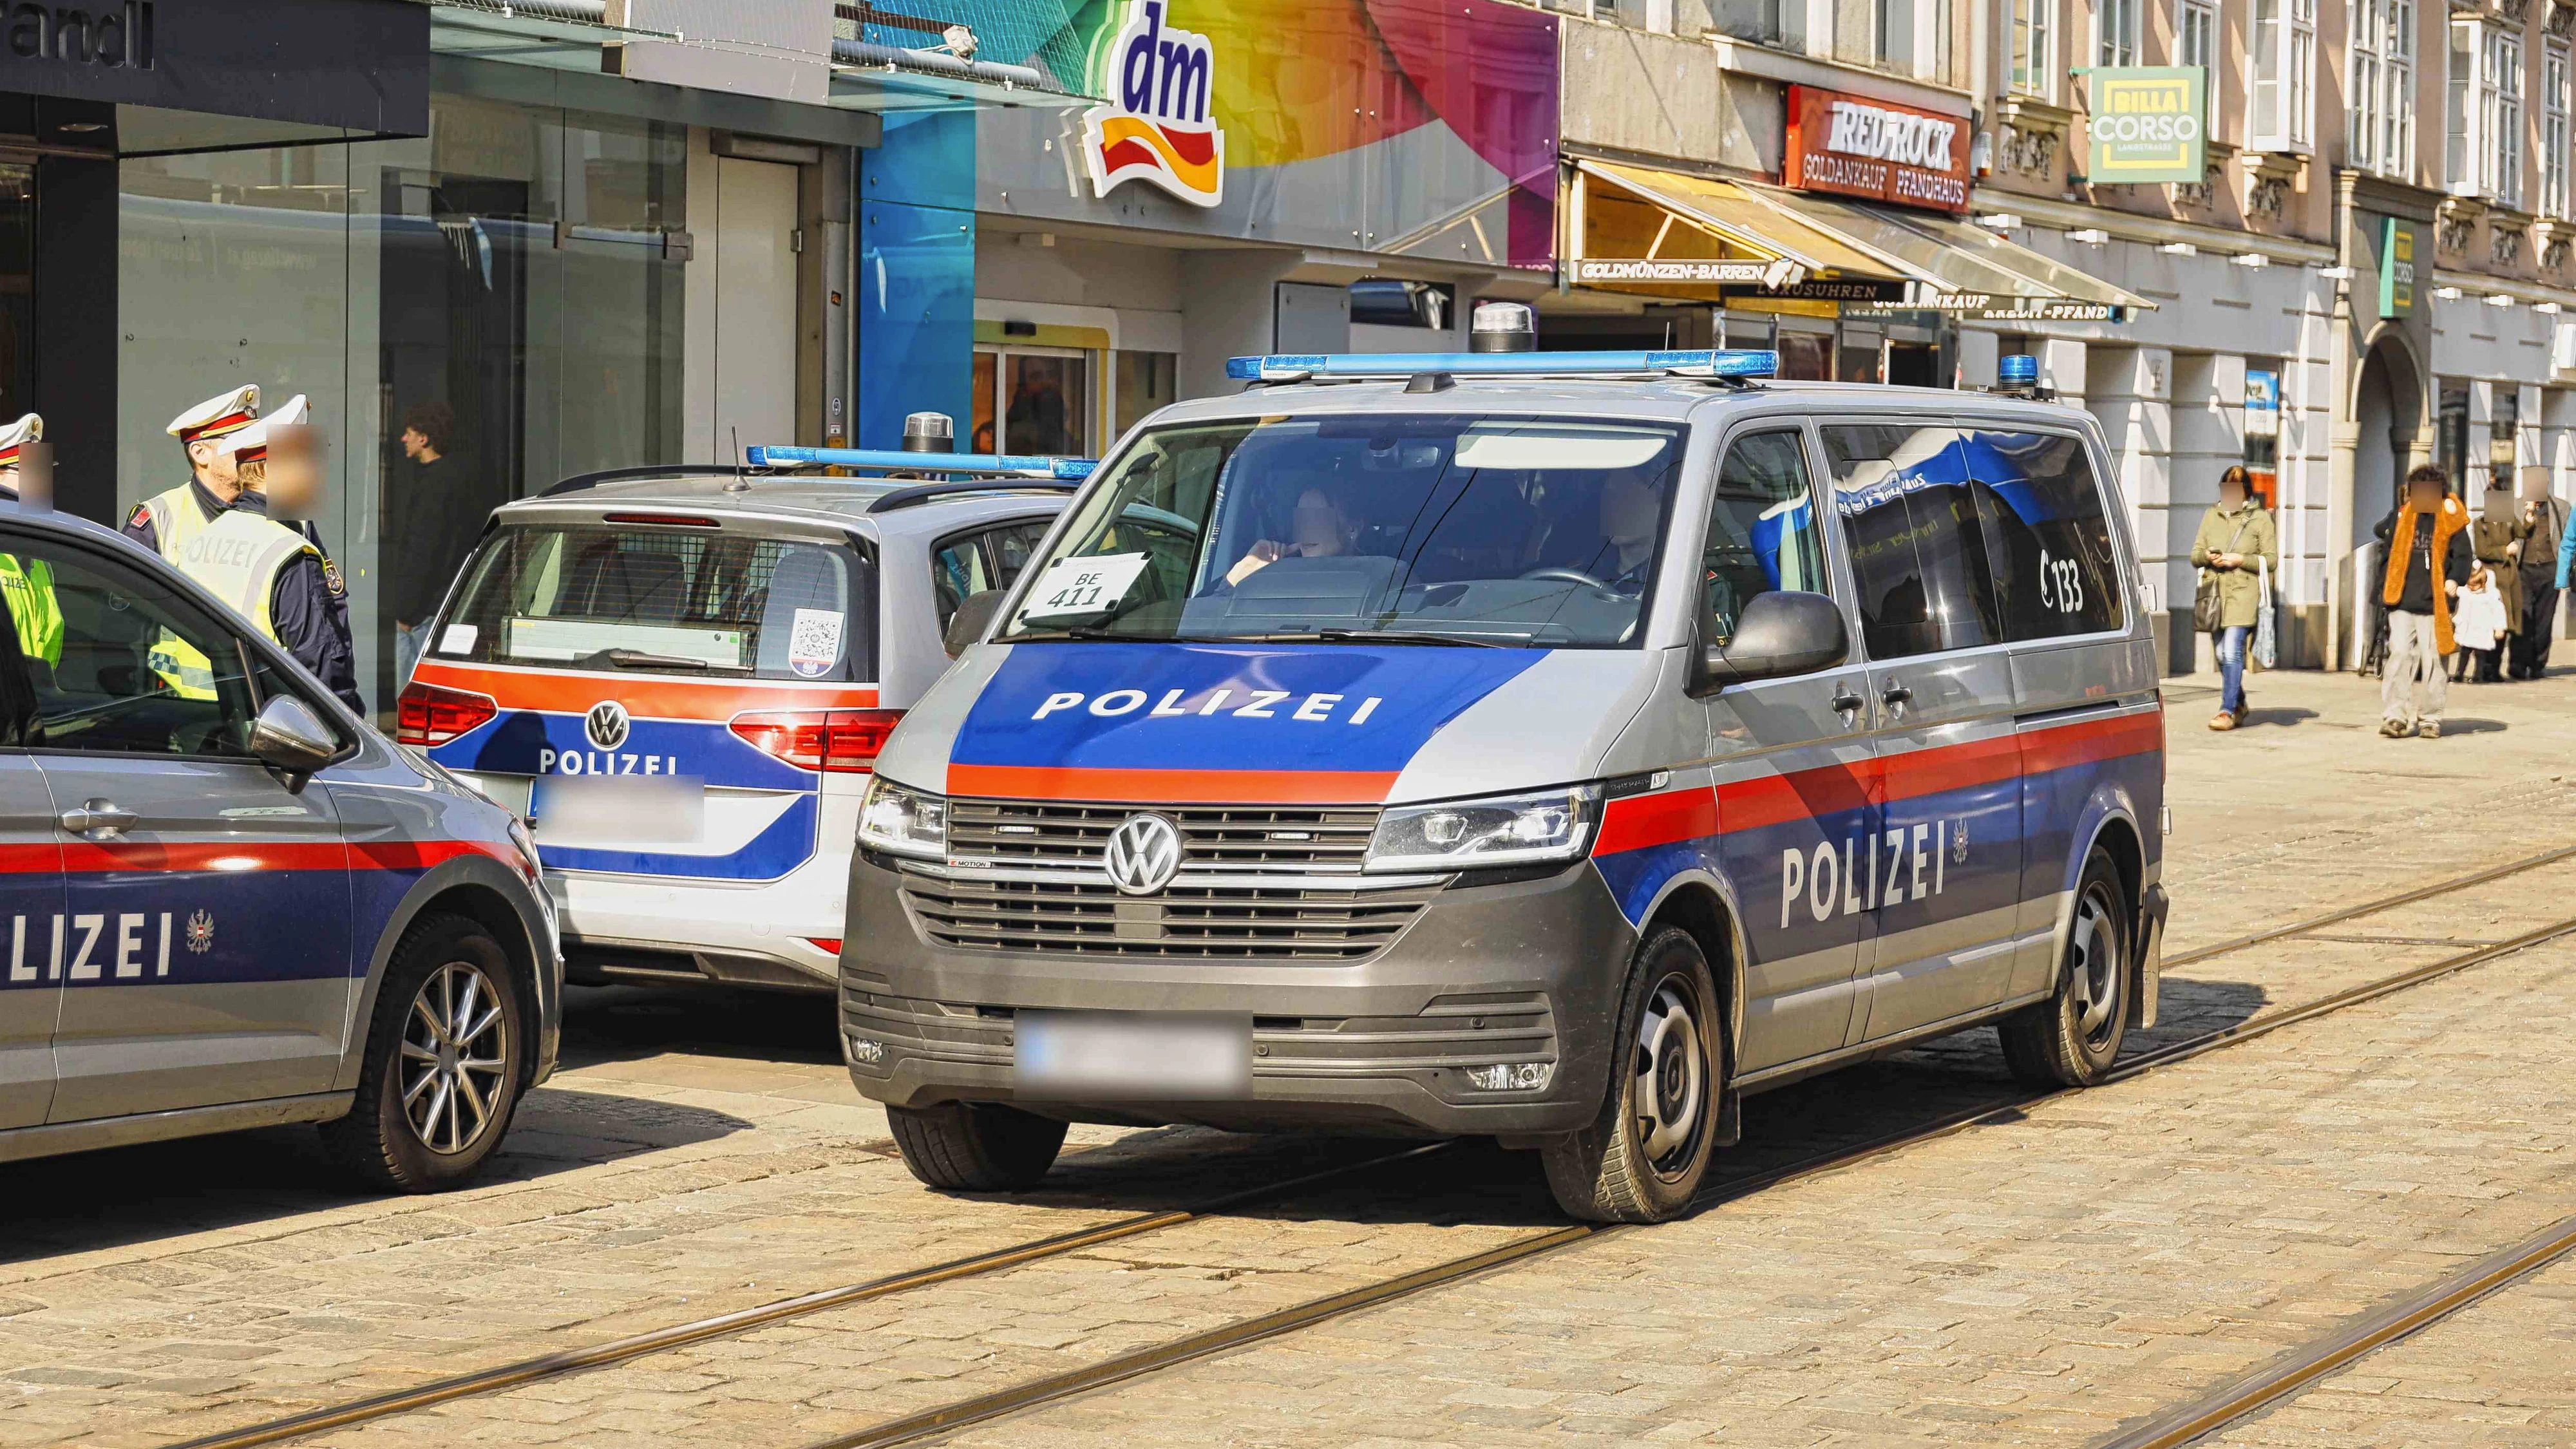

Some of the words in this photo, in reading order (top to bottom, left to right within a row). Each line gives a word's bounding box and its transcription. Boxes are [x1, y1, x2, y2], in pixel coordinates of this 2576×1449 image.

[0, 0, 154, 70] andl
[1123, 1, 1208, 123] dm
[2114, 91, 2178, 113] BILLA
[1886, 111, 1956, 171] ROCK
[2094, 108, 2199, 142] CORSO
[1803, 153, 1888, 191] GOLDANKAUF
[1895, 169, 1965, 205] PFANDHAUS
[1581, 261, 1766, 280] GOLDMÜNZEN-BARREN
[1, 576, 28, 589] OLIZE
[1047, 586, 1103, 608] 411
[1075, 573, 1103, 585] BE
[2050, 558, 2084, 613] 133
[1030, 688, 1383, 725] POLIZEI
[540, 748, 676, 775] POLIZEI
[1780, 819, 1946, 929] POLIZEI
[9, 911, 173, 981] LIZEI
